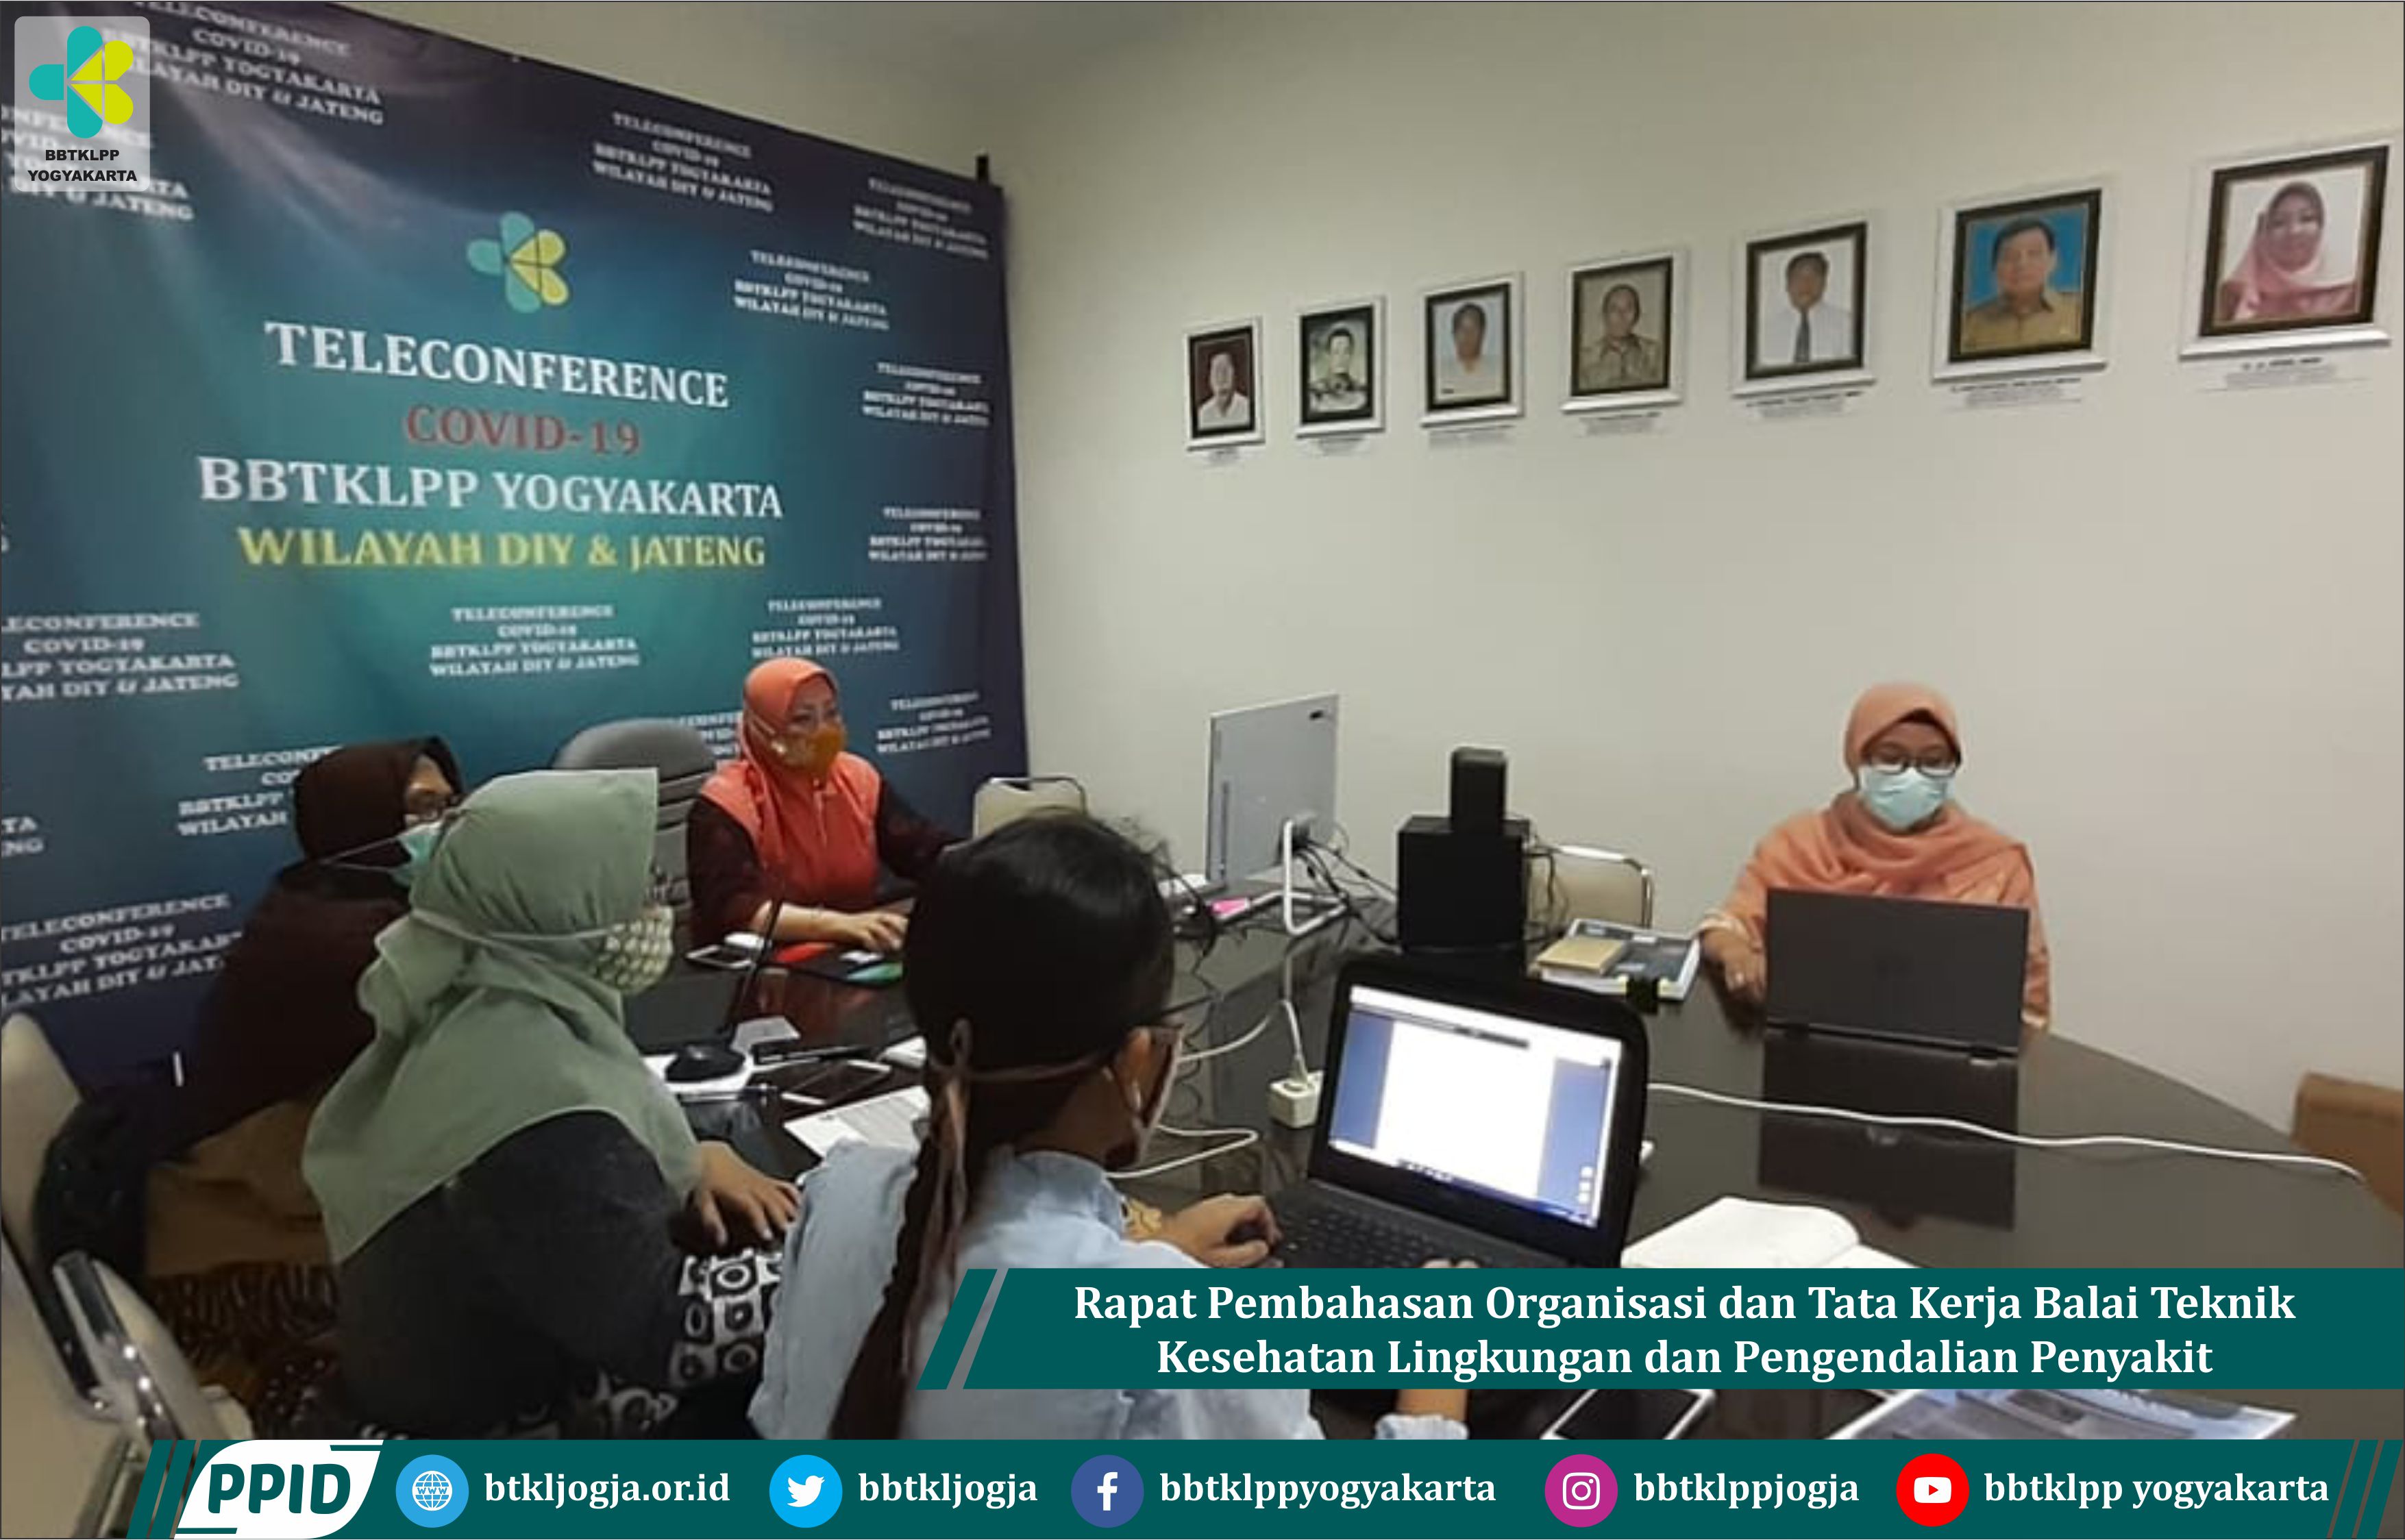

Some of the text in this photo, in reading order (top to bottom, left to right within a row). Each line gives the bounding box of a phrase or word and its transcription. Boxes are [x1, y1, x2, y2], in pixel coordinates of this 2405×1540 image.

[191, 27, 301, 65] COVID-19
[223, 56, 382, 105] YOGYAKARTA
[225, 79, 267, 102] DIY
[295, 95, 385, 126] JATENG
[265, 321, 730, 408] TELECONFERENCE
[405, 404, 641, 456] COVID-19
[197, 456, 783, 519] BBTKLPP YOGYAKARTA
[237, 526, 765, 573] WILAYAH DIY & JATENG
[1, 612, 199, 633] ECONFERENCE
[23, 636, 145, 654] COVID-19
[57, 654, 235, 675] YOGYAKARTA
[62, 680, 112, 698] DIY
[141, 673, 240, 694] JATENG
[204, 743, 342, 771] TELECONF
[178, 791, 284, 817] BBTKLPP
[177, 810, 288, 836] WILAYAH
[60, 923, 174, 954] COVID-19
[97, 967, 142, 991] DIY
